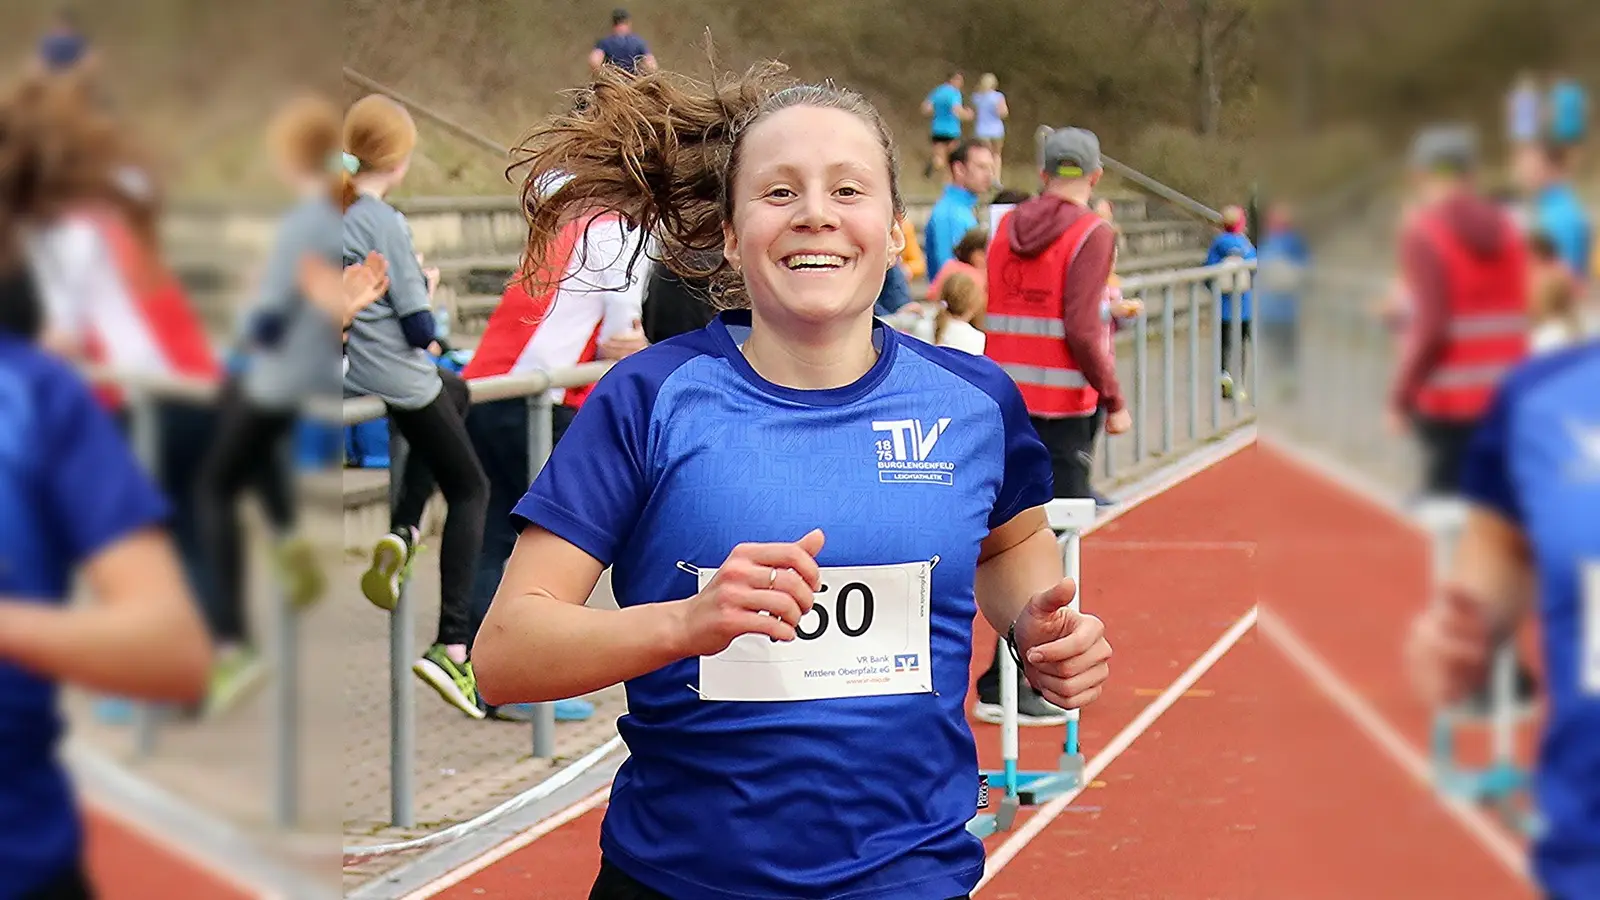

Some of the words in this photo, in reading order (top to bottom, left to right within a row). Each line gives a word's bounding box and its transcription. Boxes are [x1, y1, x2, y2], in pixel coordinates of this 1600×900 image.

[874, 439, 892, 451] 18
[876, 450, 894, 461] 75
[877, 461, 955, 470] BURGLENGENFELD
[870, 655, 889, 663] Bank
[804, 669, 835, 677] Mittlere
[838, 666, 877, 676] Oberpfalz
